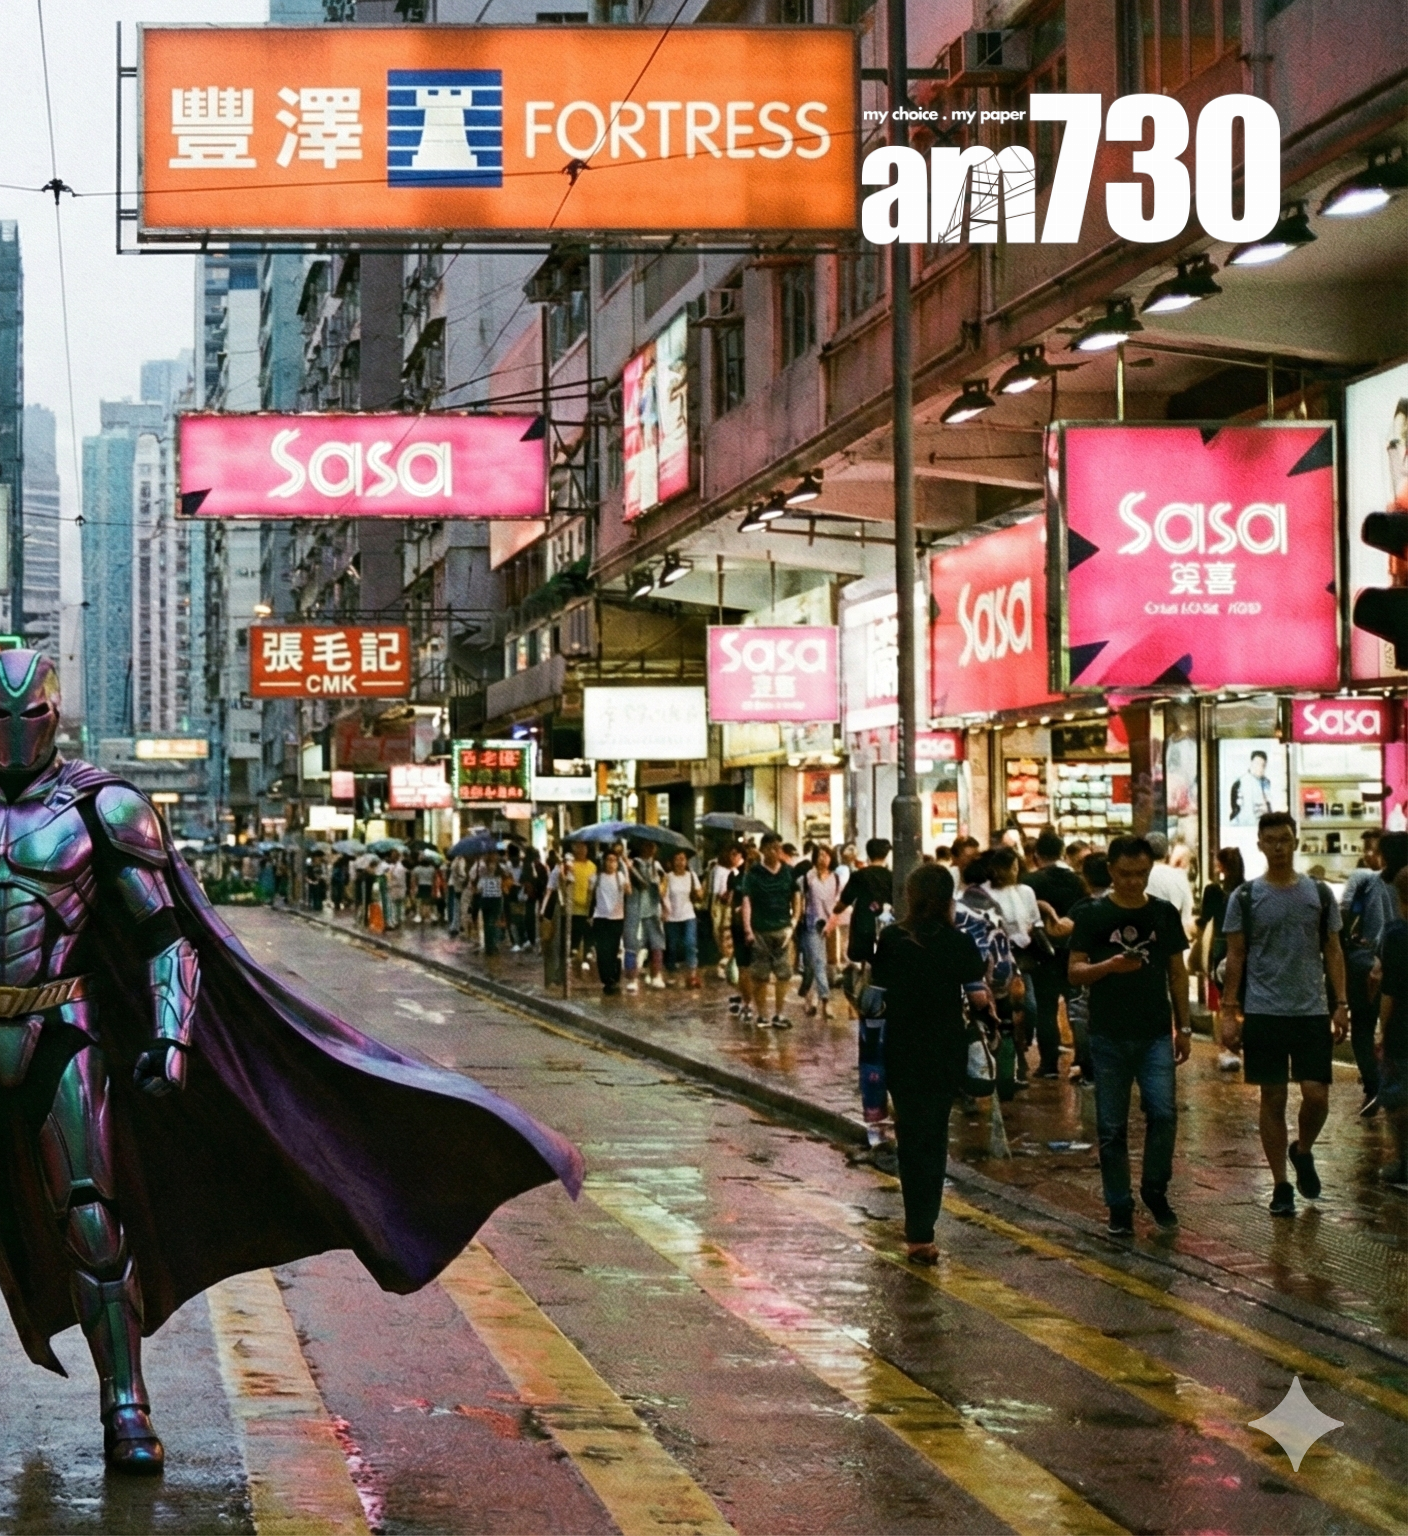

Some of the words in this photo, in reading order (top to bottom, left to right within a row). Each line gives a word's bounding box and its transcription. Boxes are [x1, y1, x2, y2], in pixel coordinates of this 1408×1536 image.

[169, 86, 362, 169] 豐澤
[525, 101, 831, 160] FORTRESS
[268, 428, 453, 498] Sasa
[1117, 491, 1288, 555] Sasa
[262, 631, 402, 673] 張毛記
[958, 577, 1032, 668] Sasa
[719, 632, 828, 674] Sasa
[305, 674, 358, 694] CMK
[1302, 703, 1381, 736] Sasa
